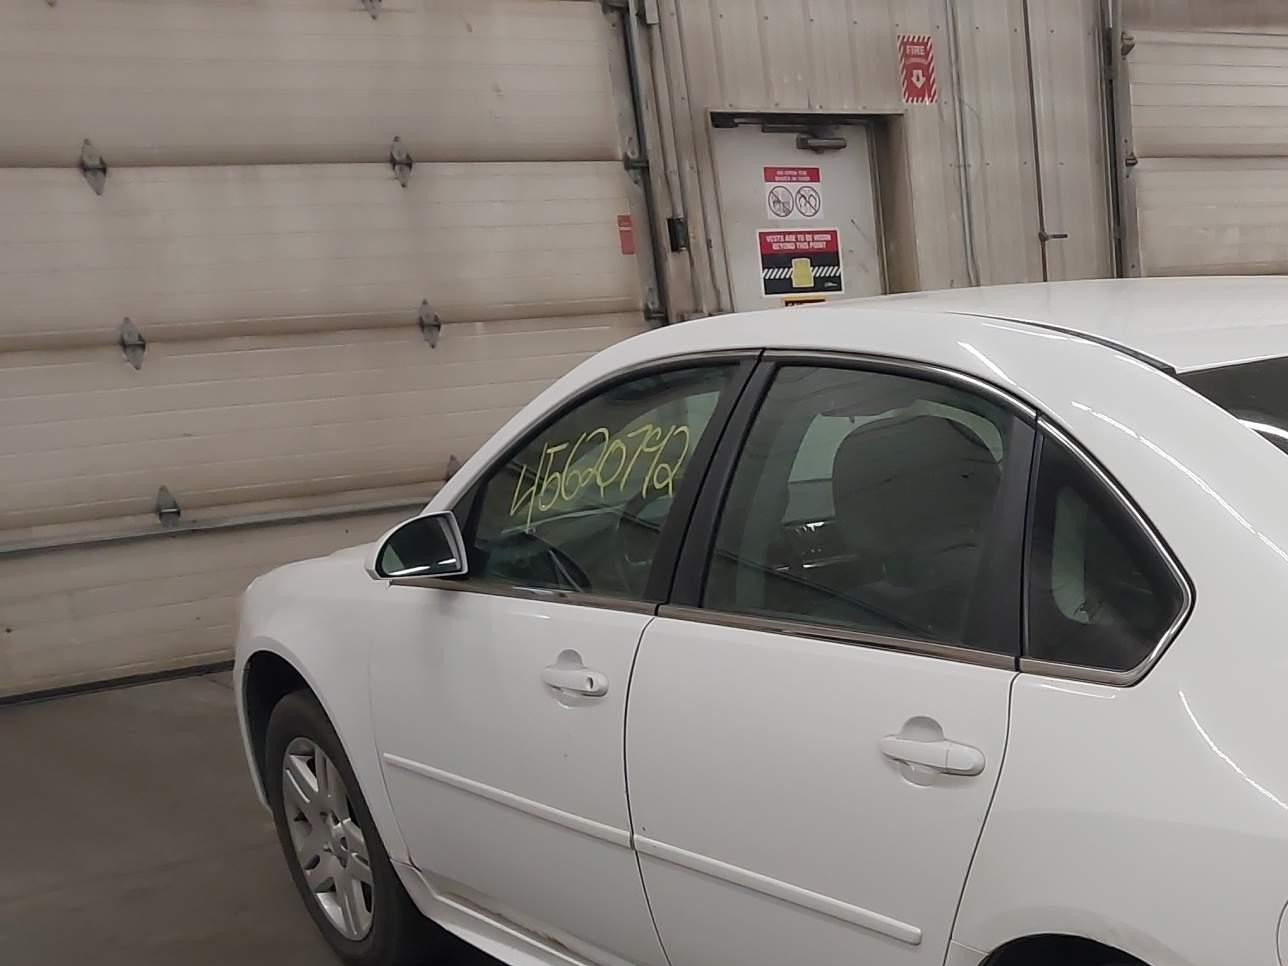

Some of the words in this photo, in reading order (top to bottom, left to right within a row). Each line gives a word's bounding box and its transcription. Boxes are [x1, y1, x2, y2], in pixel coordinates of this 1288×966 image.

[906, 45, 925, 55] FIRE
[766, 235, 784, 243] VESTS
[510, 423, 689, 533] 45620792
